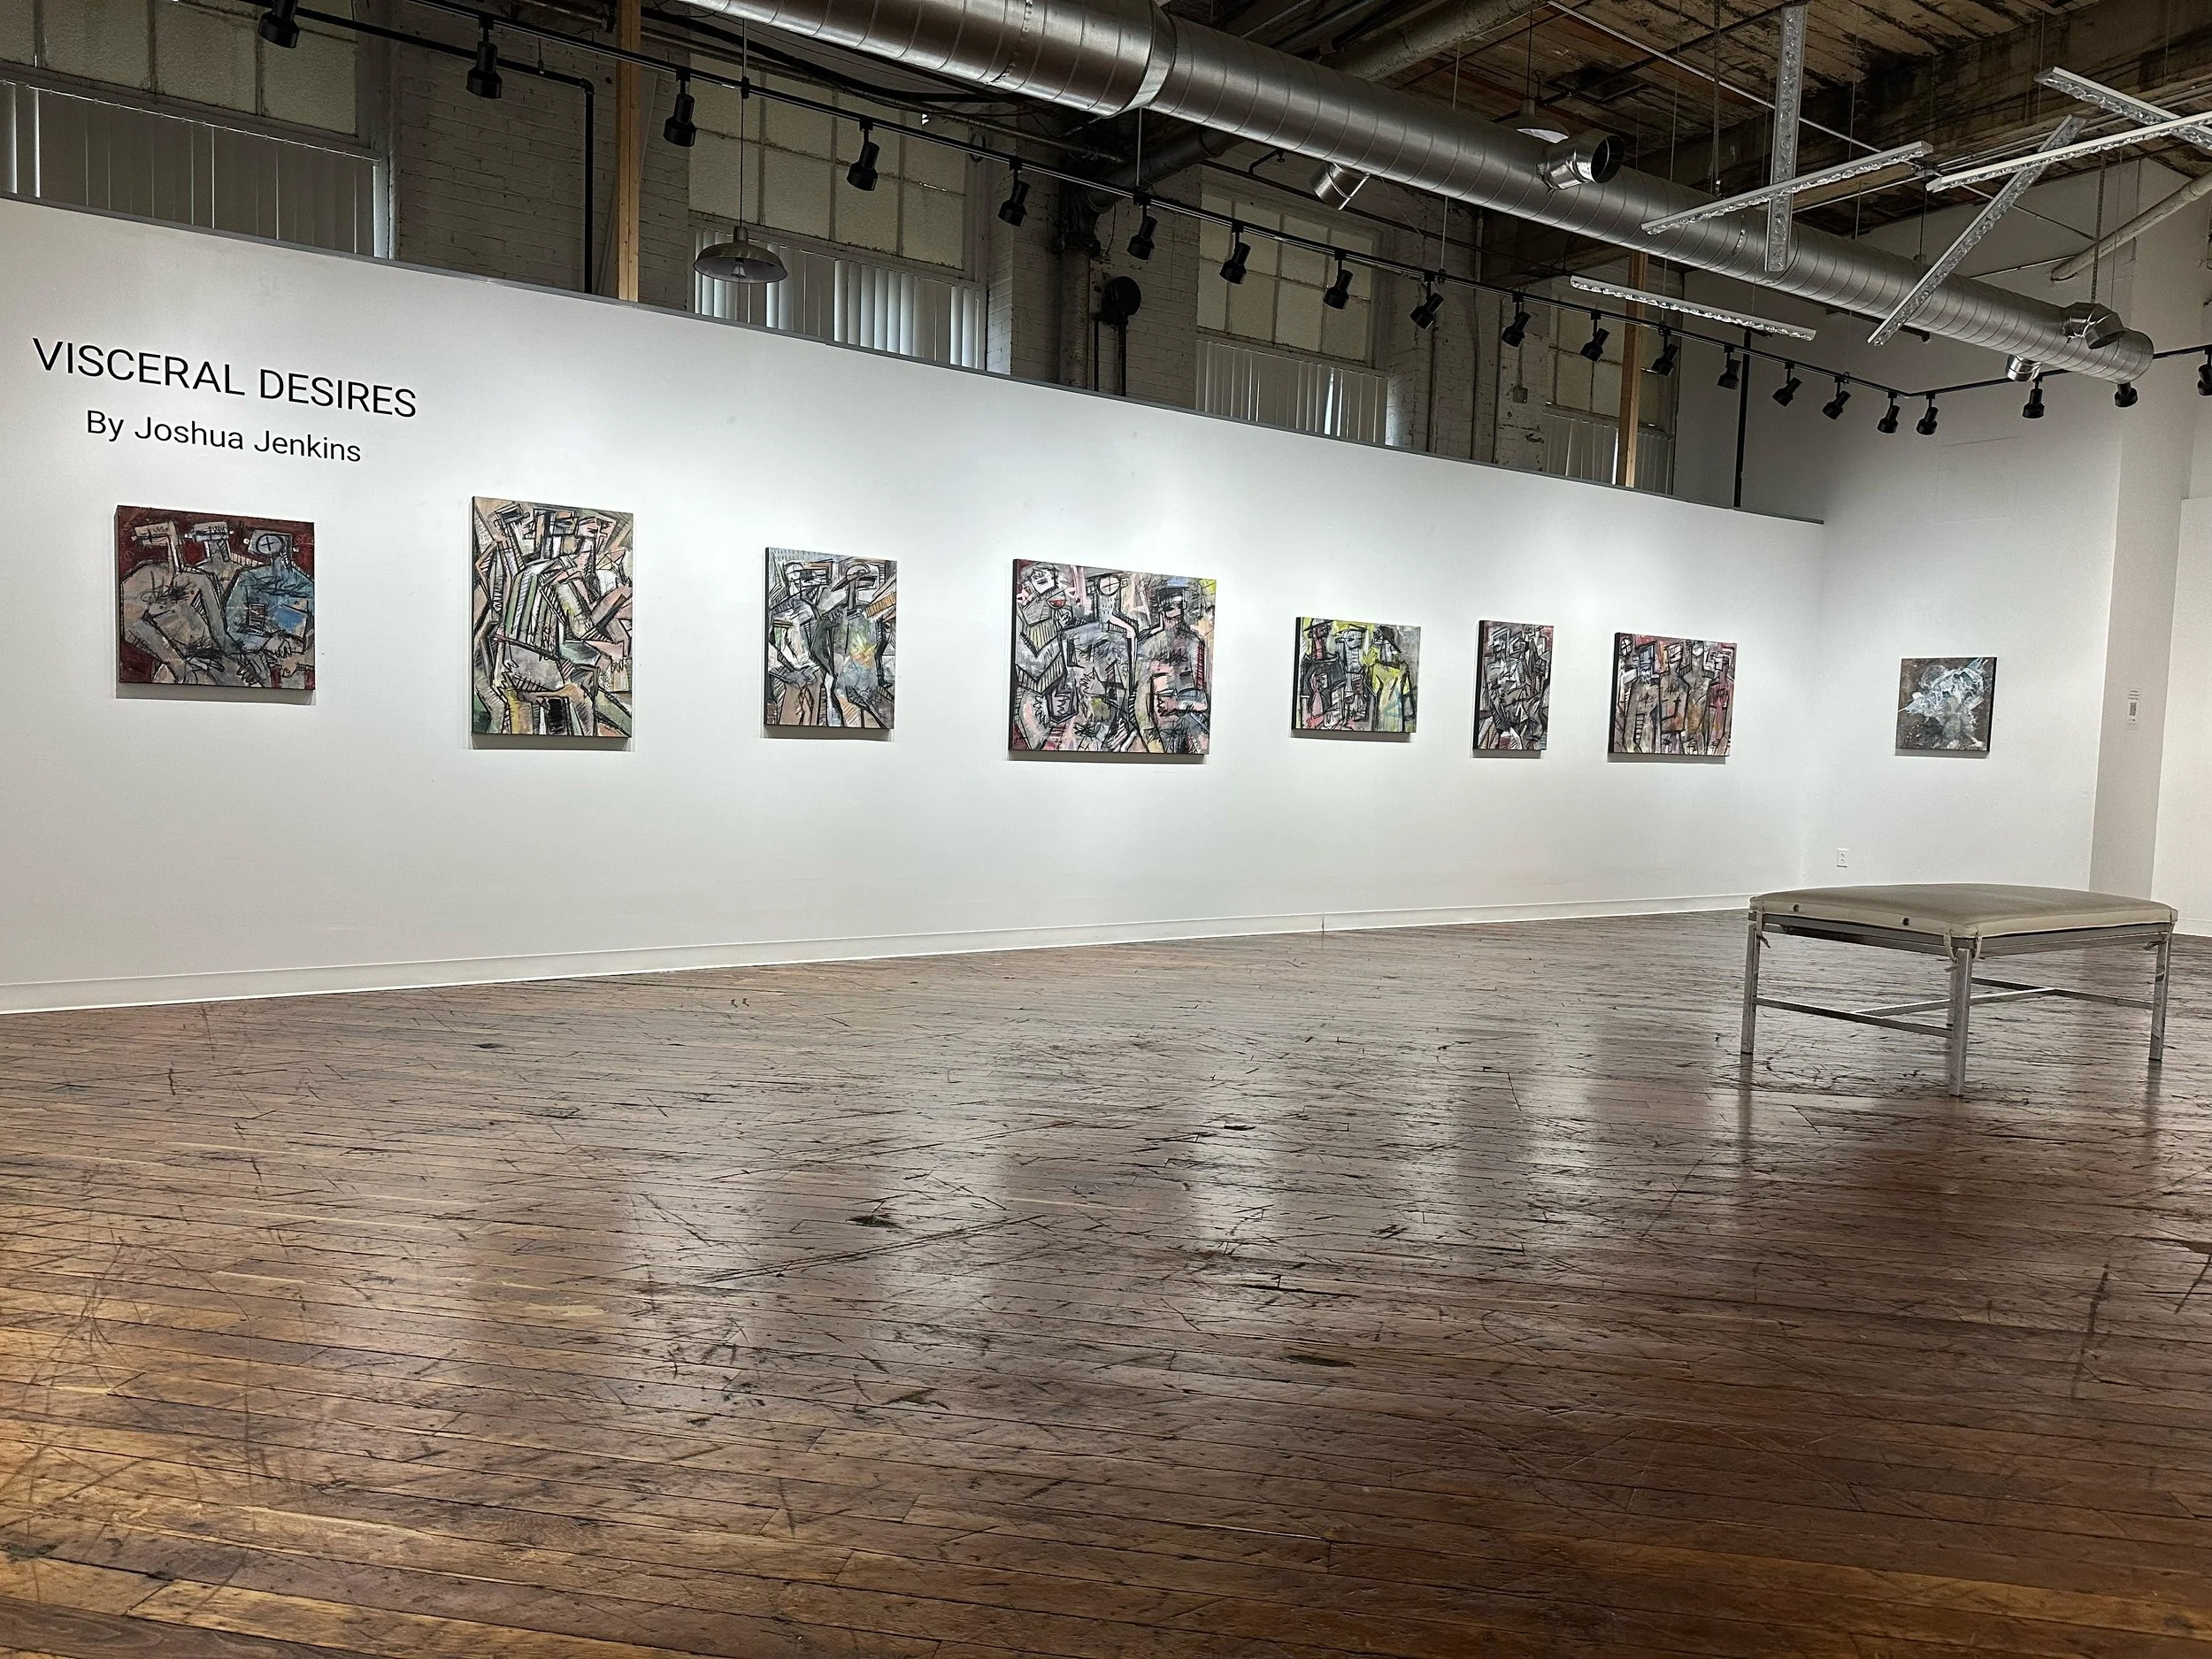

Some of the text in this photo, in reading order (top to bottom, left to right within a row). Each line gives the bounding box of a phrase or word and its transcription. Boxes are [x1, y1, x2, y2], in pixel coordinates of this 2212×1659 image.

[32, 337, 417, 419] VISCERAL DESIRES
[87, 410, 362, 463] By Joshua Jenkins
